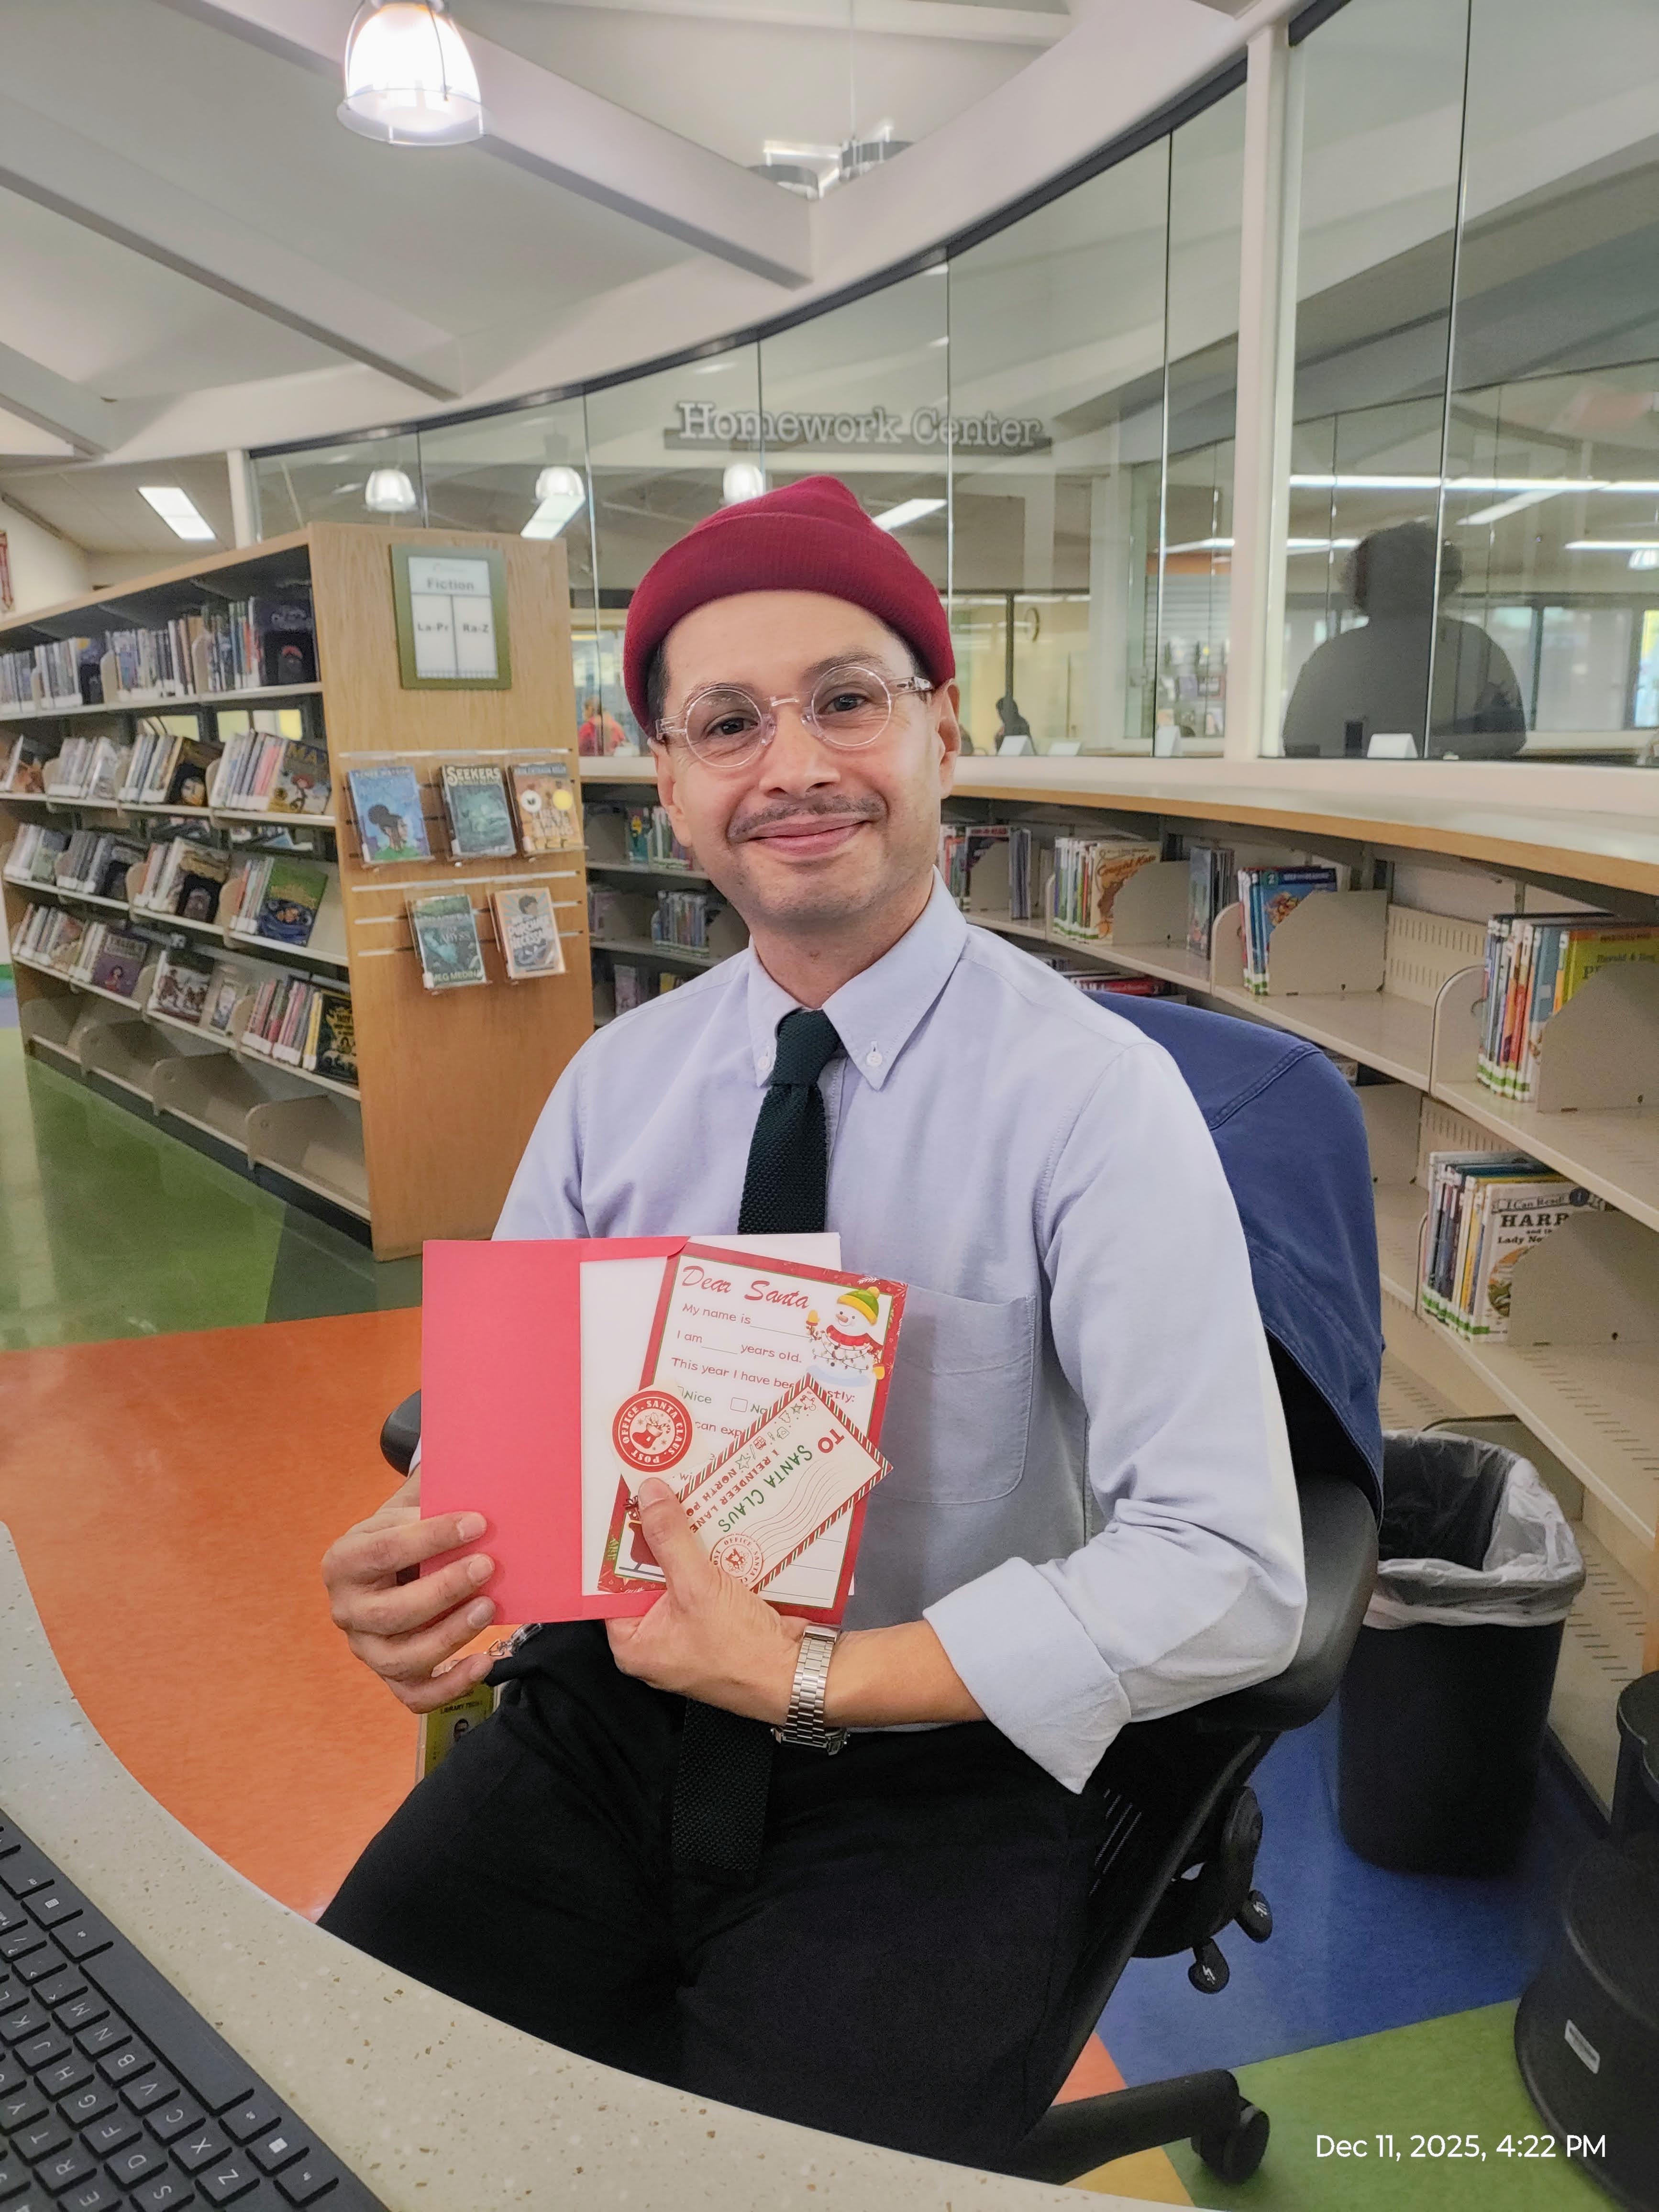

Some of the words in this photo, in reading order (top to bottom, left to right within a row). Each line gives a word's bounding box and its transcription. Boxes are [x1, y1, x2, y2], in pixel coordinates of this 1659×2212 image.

[677, 401, 902, 444] Homework
[910, 407, 1044, 447] Center
[427, 578, 475, 591] Fiction
[446, 766, 501, 787] SEEKERS
[1497, 1236, 1525, 1245] Lady
[682, 1265, 731, 1294] Dear
[744, 1280, 809, 1309] Santa
[682, 1303, 699, 1316] My
[703, 1308, 737, 1322] name
[741, 1314, 751, 1324] is
[677, 1330, 681, 1339] I
[684, 1334, 702, 1343] am
[741, 1344, 775, 1358] years
[779, 1351, 802, 1363] old.
[671, 1357, 698, 1371] This
[701, 1364, 730, 1377] year
[734, 1370, 737, 1379] I
[741, 1371, 770, 1385] have
[827, 1390, 855, 1403] stly:
[684, 1389, 712, 1404] Nice
[646, 1400, 678, 1419] SANTA
[621, 1405, 640, 1444] OFFICE
[668, 1422, 684, 1455] CLAUS
[818, 1428, 845, 1454] TO
[630, 1449, 660, 1464] POST
[763, 1445, 813, 1488] SANTA
[701, 1468, 738, 1502] NORTH
[719, 1456, 772, 1505] REINDEER
[686, 1501, 701, 1517] PO
[718, 1489, 765, 1533] CLAUS
[689, 1504, 719, 1533] LANE
[724, 1537, 752, 1547] OFFICE
[71, 2002, 91, 2017] M
[11, 2014, 31, 2028] K
[94, 2027, 113, 2041] N
[33, 2041, 51, 2050] J
[118, 2054, 136, 2068] B
[55, 2066, 75, 2081] H
[140, 2082, 157, 2096] V
[7, 2102, 26, 2115] Y
[78, 2094, 96, 2108] G
[166, 2109, 184, 2123] C
[30, 2131, 49, 2145] T
[101, 2126, 122, 2138] F
[191, 2137, 212, 2155] X
[55, 2158, 75, 2175] R
[127, 2154, 147, 2169] D
[218, 2168, 239, 2185] Z
[153, 2185, 172, 2200] S
